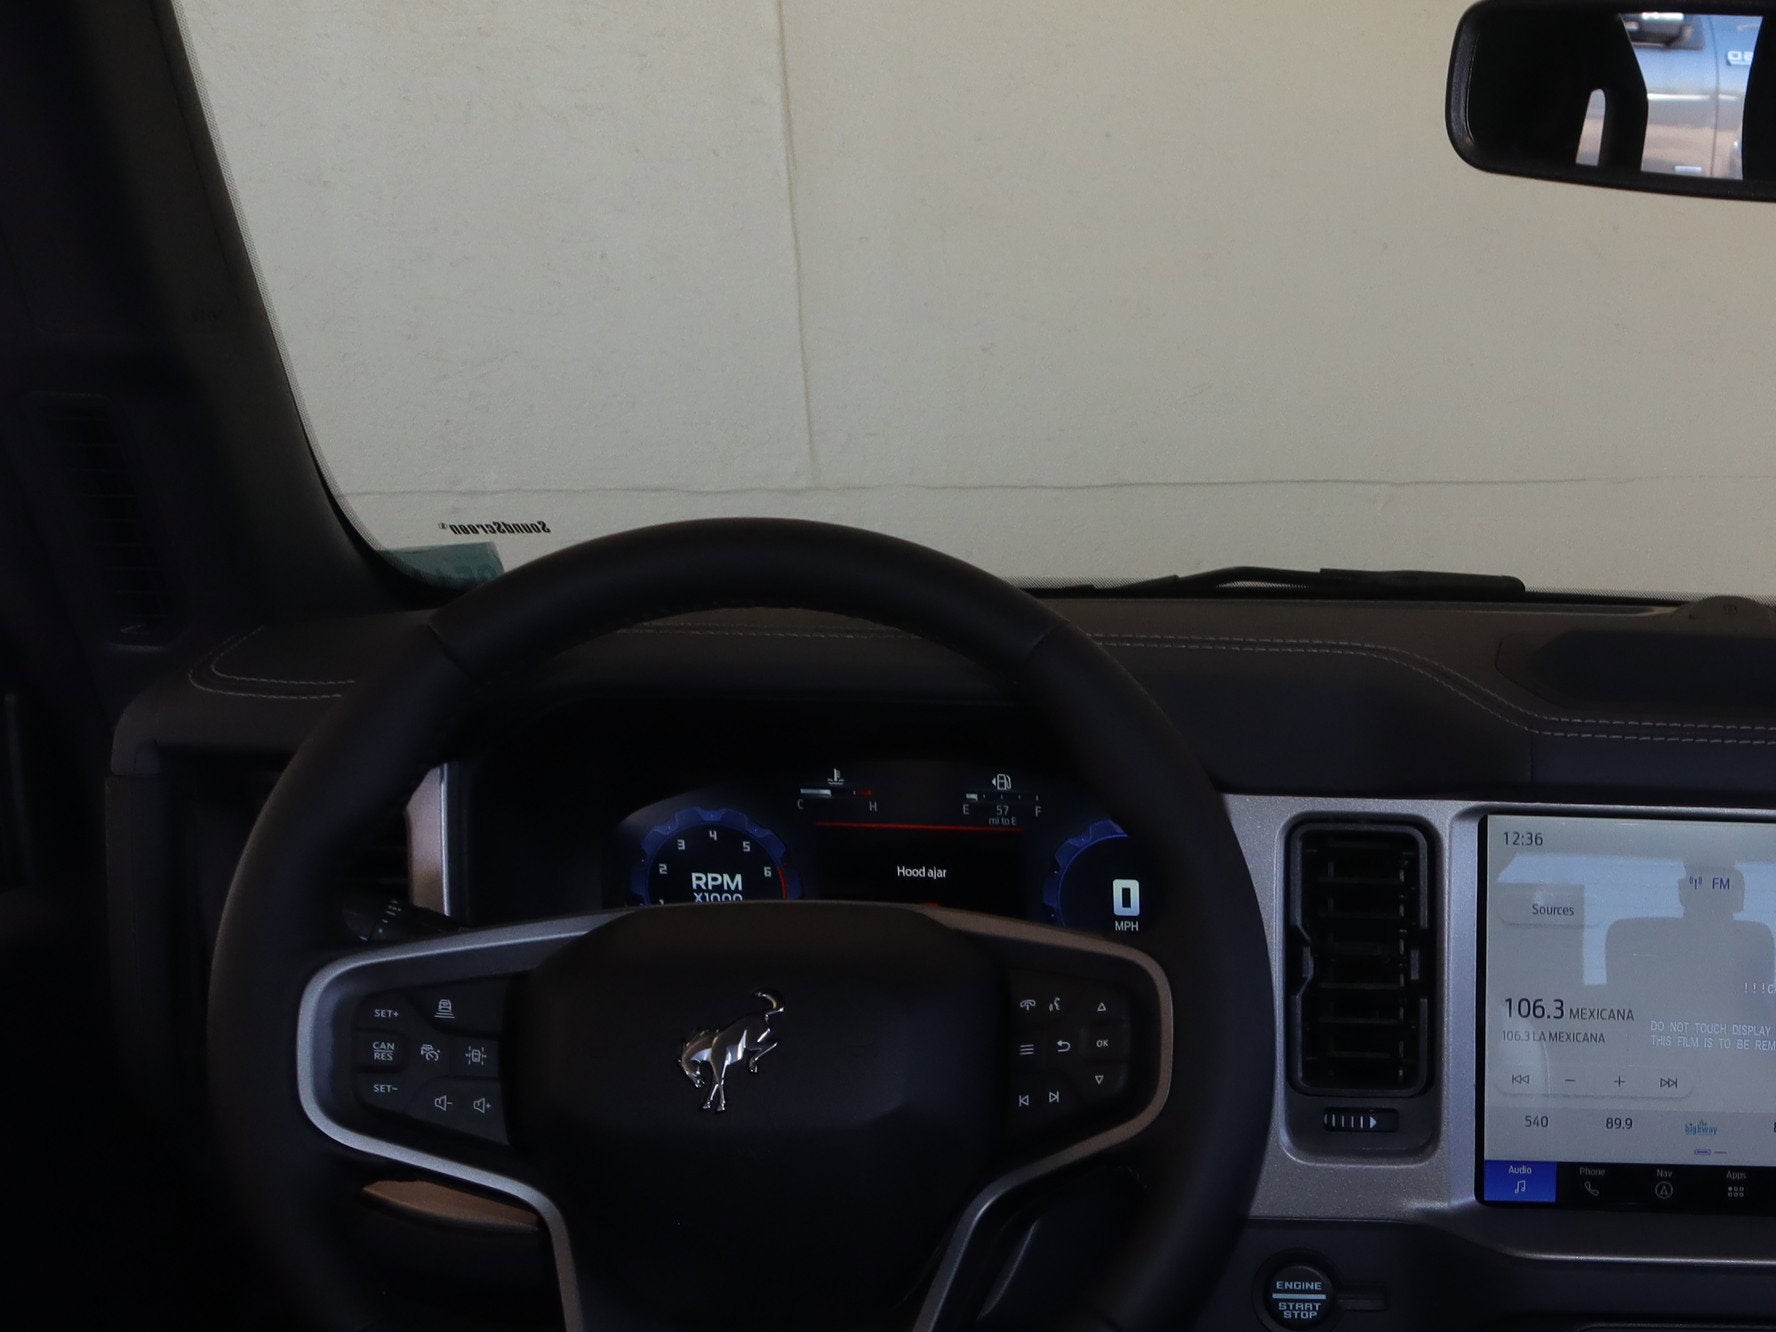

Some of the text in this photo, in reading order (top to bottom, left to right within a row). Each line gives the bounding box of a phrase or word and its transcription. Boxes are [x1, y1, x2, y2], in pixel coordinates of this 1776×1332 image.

[869, 801, 877, 812] H
[963, 804, 970, 815] E
[996, 805, 1009, 815] 57
[1035, 806, 1042, 817] F
[709, 830, 718, 841] 4
[1503, 831, 1543, 847] 12:36
[677, 840, 685, 850] 3
[743, 841, 751, 852] 5
[659, 863, 668, 874] 2
[764, 867, 772, 877] 6
[897, 866, 948, 880] Hood ajar
[691, 872, 743, 891] RPM
[1712, 878, 1730, 890] FM
[1113, 879, 1140, 916] 0
[1531, 904, 1575, 916] Sources
[1115, 921, 1139, 931] MPH
[374, 1009, 399, 1018] SET+
[1504, 998, 1634, 1021] 106.3 MEXICANA
[1650, 1020, 1665, 1031] DO
[1670, 1021, 1690, 1032] NOT
[1695, 1022, 1727, 1034] TOUCH
[1732, 1024, 1771, 1036] DISPLAY
[1502, 1031, 1605, 1044] 106.3 LA MEXICANA
[1651, 1035, 1672, 1047] THIS
[1677, 1036, 1699, 1048] FILM
[1704, 1037, 1713, 1048] IS
[1720, 1038, 1731, 1049] TO
[1737, 1039, 1750, 1050] BE
[372, 1041, 395, 1050] CAN
[1096, 1039, 1109, 1048] OK
[373, 1052, 393, 1061] RES
[1524, 1115, 1549, 1128] 540
[1605, 1117, 1633, 1130] 89.9
[1508, 1164, 1532, 1175] Audio
[1579, 1166, 1606, 1177] Phone
[1656, 1168, 1673, 1178] Nav
[1726, 1170, 1747, 1182] Apps
[1276, 1281, 1324, 1291] ENGINE
[1278, 1302, 1321, 1311] START
[1283, 1311, 1317, 1319] STOP
